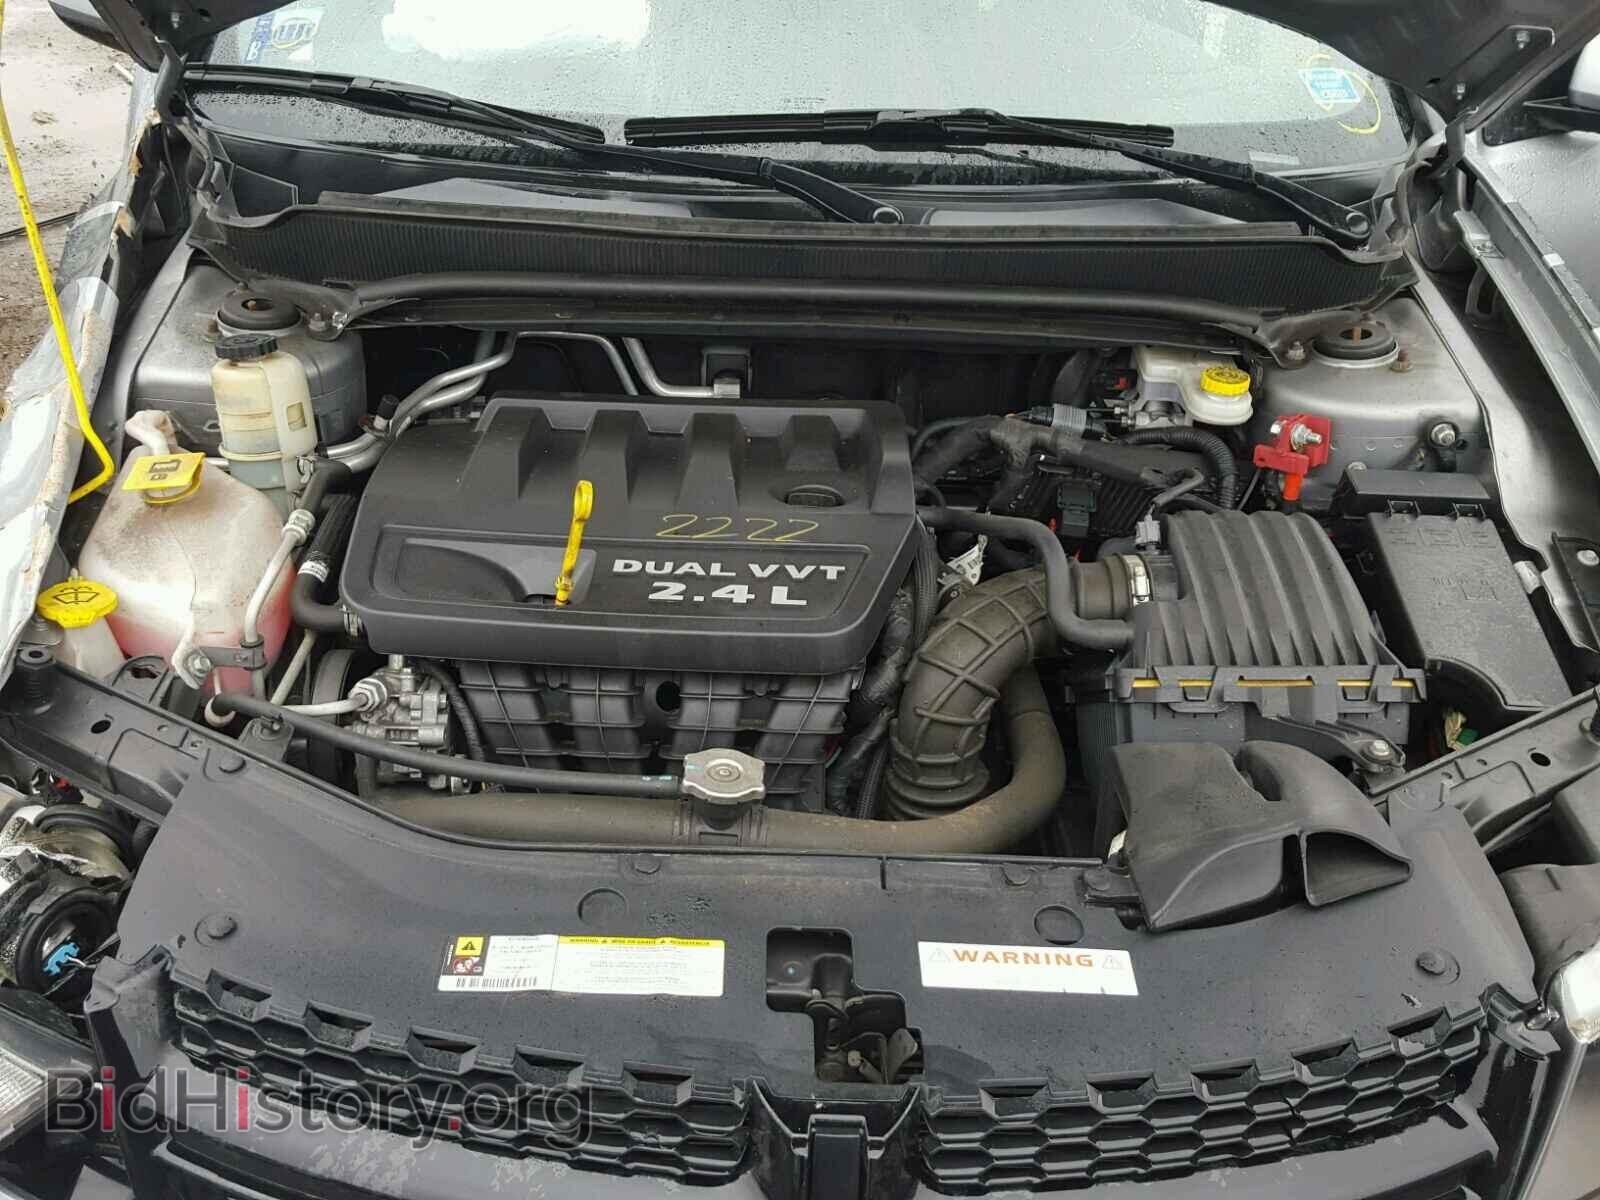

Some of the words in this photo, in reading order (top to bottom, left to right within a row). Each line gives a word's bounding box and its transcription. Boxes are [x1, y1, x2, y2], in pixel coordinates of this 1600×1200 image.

[612, 559, 737, 577] DUAL
[748, 563, 846, 580] VVT
[952, 948, 1094, 968] WARNING
